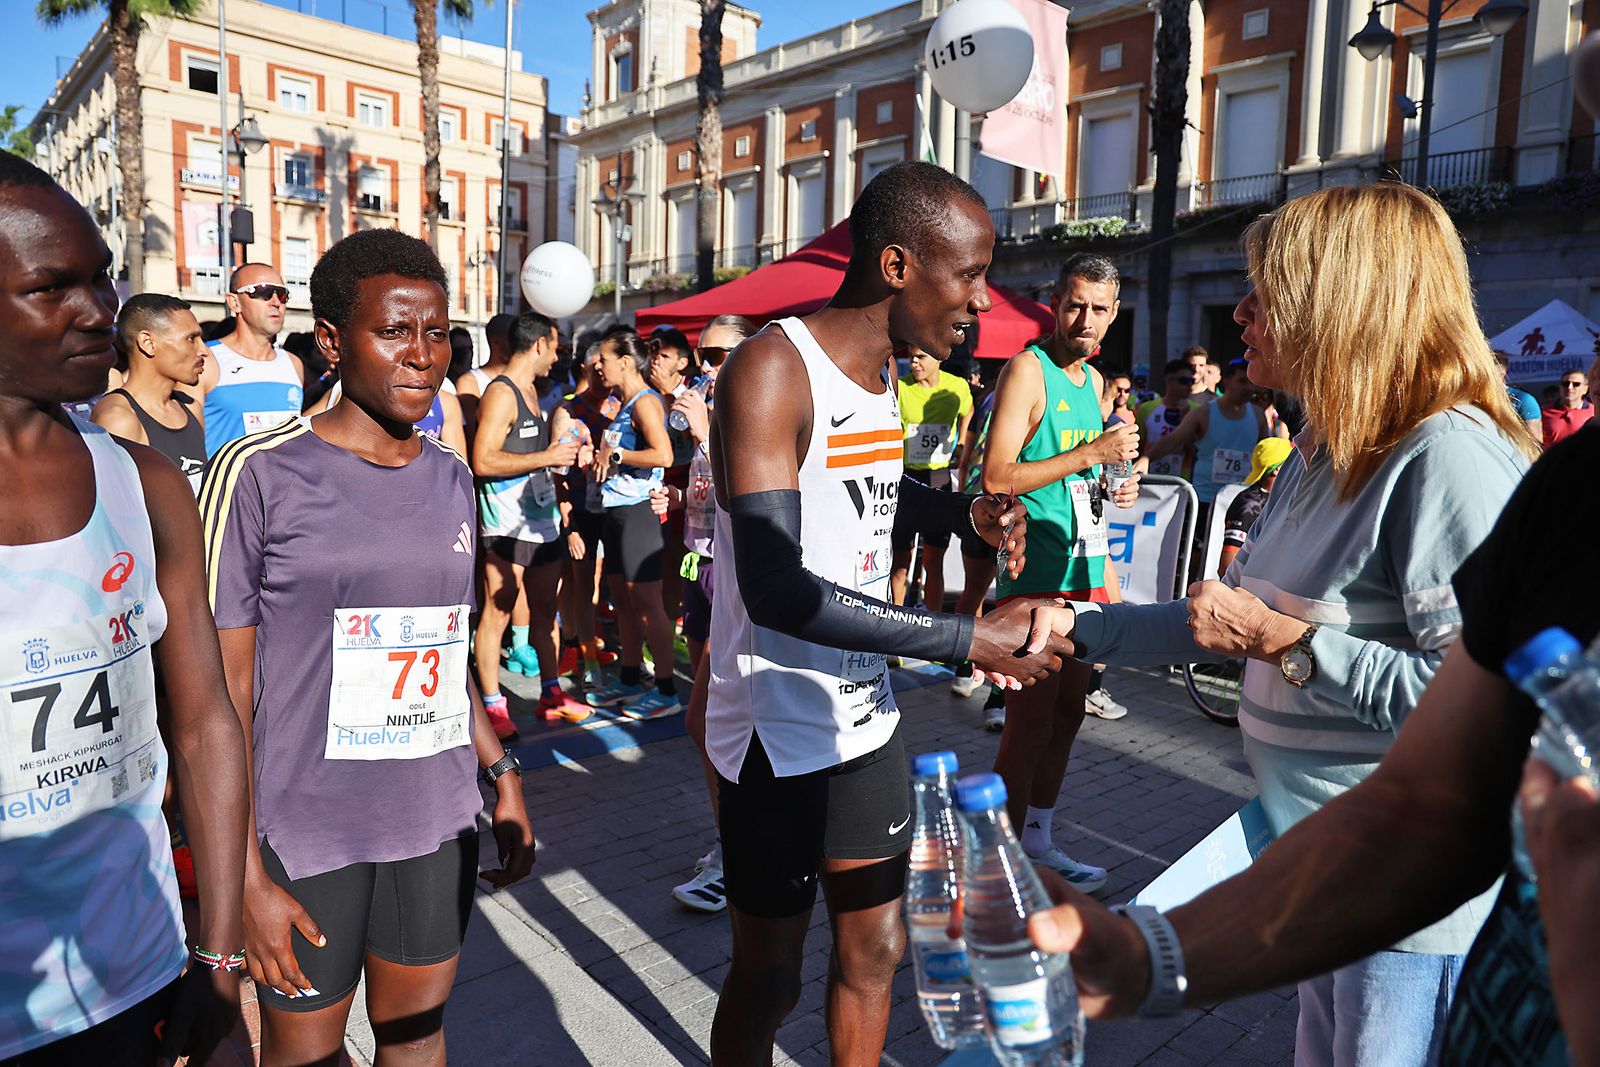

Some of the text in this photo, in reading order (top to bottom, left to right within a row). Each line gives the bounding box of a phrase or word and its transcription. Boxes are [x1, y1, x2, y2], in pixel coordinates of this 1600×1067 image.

[931, 34, 976, 69] 1:15
[921, 434, 939, 448] 59
[1155, 462, 1171, 473] 29
[1225, 459, 1241, 472] 78
[863, 549, 879, 572] 21K
[835, 591, 933, 628] TOP4RUNNING
[109, 610, 138, 645] 21K
[346, 614, 381, 638] 21K
[113, 638, 142, 659] HUELVA
[346, 638, 382, 647] HUELVA
[54, 650, 98, 665] HUELVA
[388, 649, 440, 700] 73
[11, 670, 120, 753] 74
[386, 711, 436, 726] NINTIJE
[73, 735, 123, 757] KIPKURGAT
[337, 727, 411, 745] Huelva
[19, 753, 71, 771] MESHACK
[36, 755, 109, 789] KIRWA
[0, 786, 72, 822] elva
